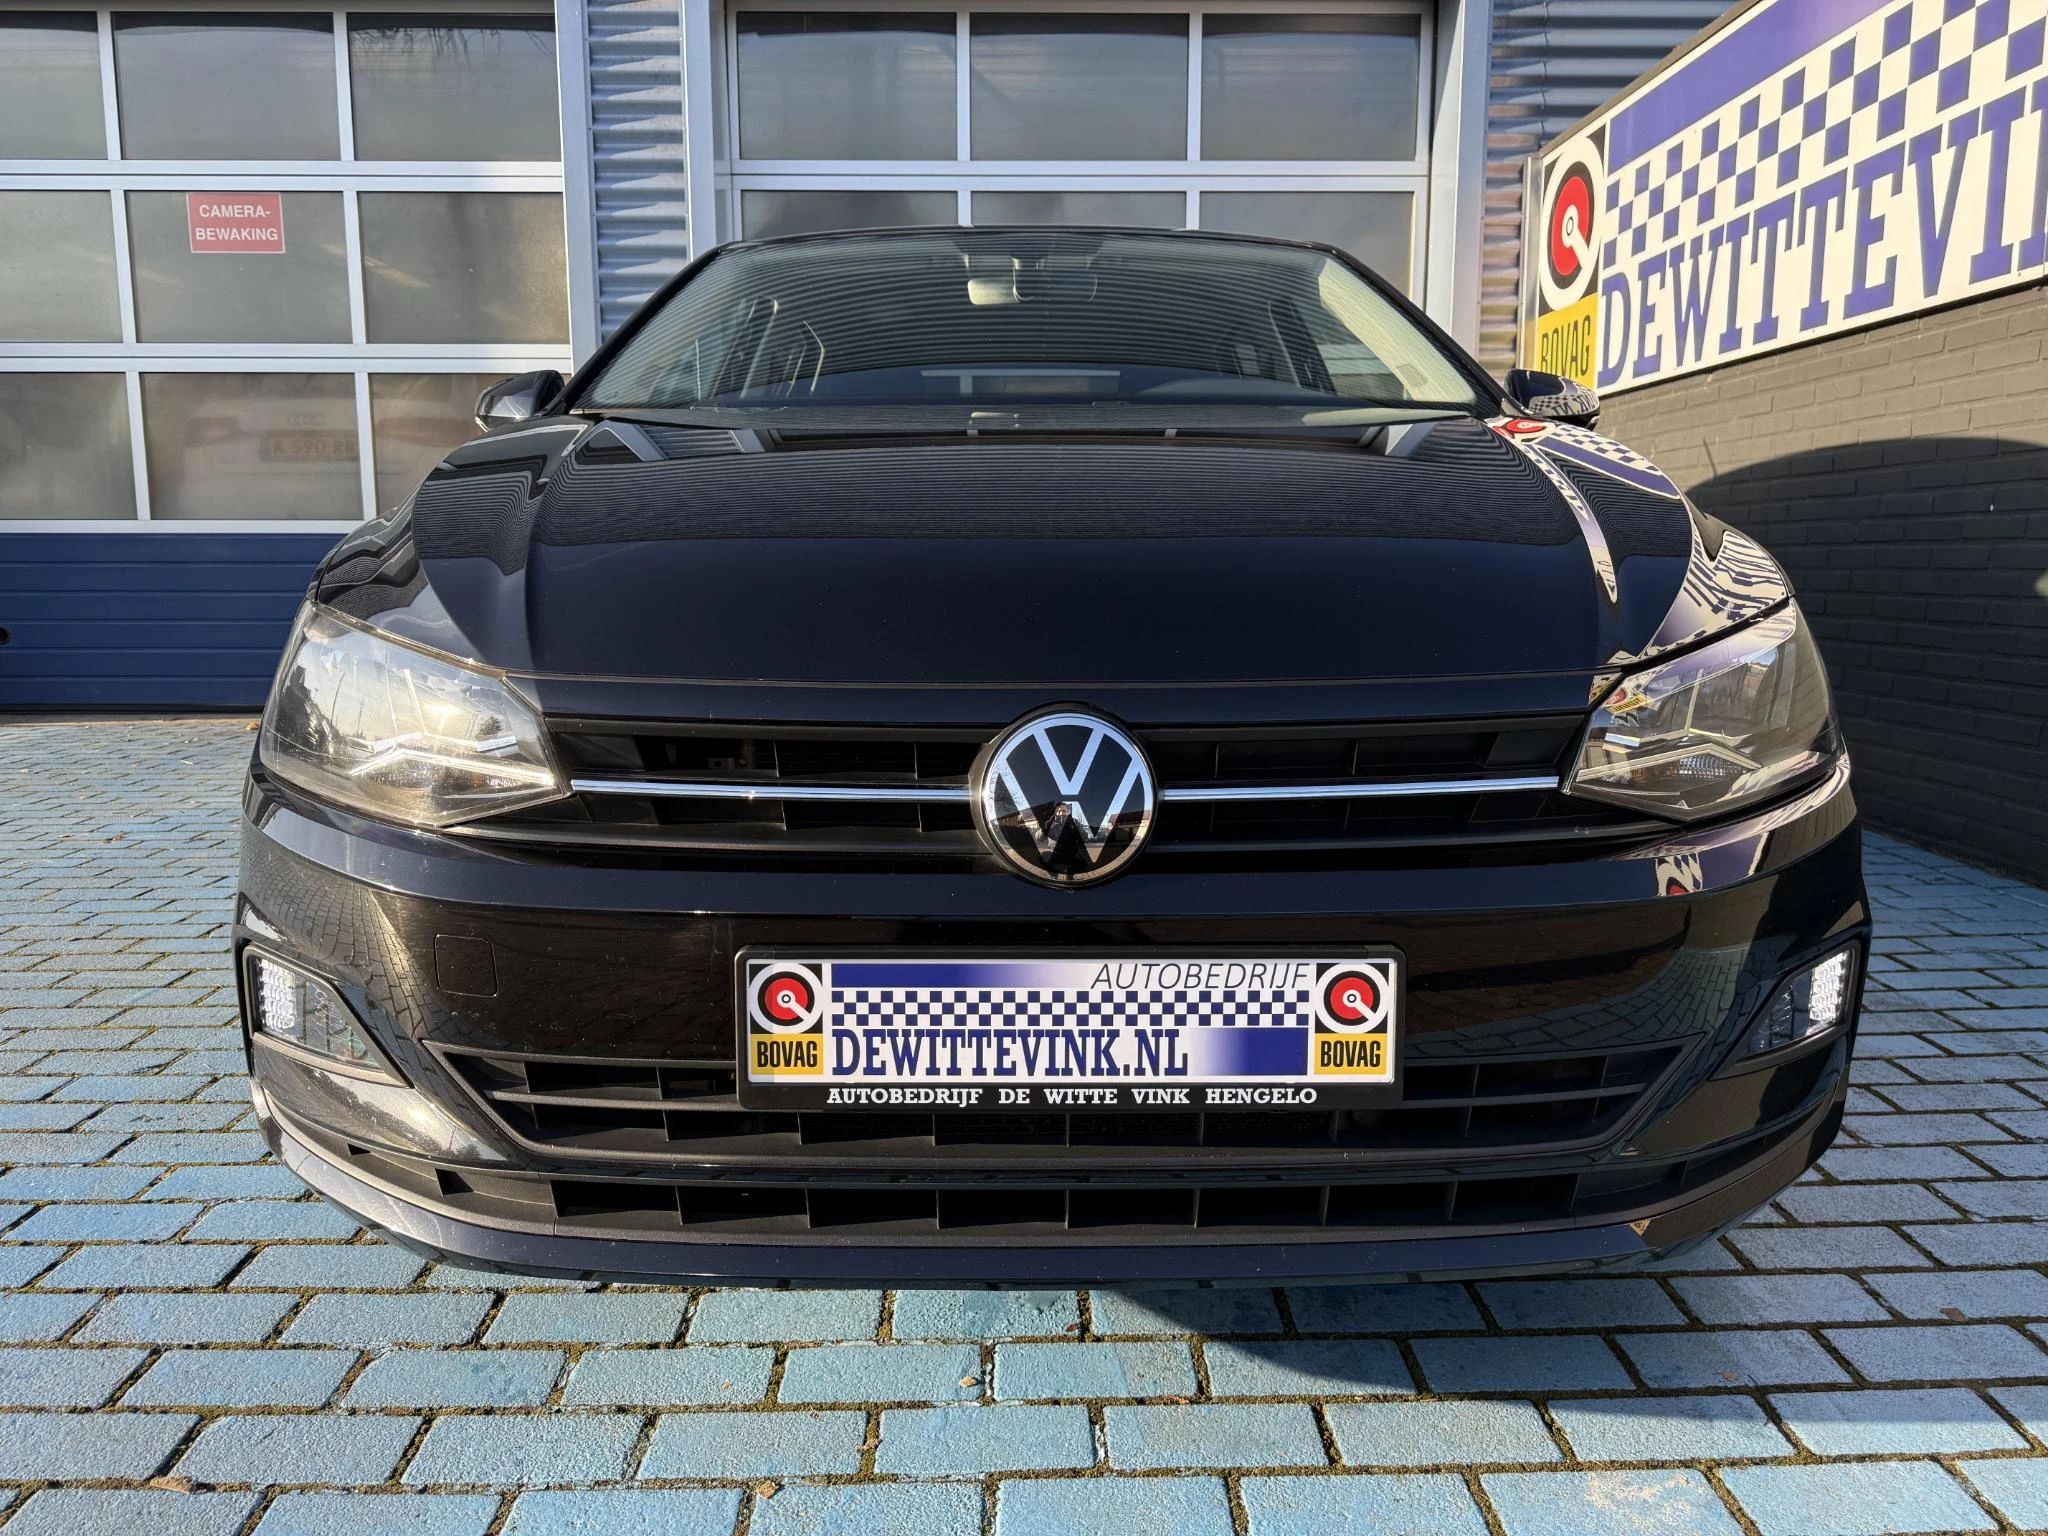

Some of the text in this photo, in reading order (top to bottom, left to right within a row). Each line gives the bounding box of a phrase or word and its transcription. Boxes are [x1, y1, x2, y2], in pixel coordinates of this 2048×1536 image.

[199, 204, 271, 218] CAMERA-
[195, 227, 279, 241] BEWAKING
[1540, 314, 1592, 379] BOVAG
[1090, 962, 1311, 990] AUTOBEDRIJF
[756, 1040, 819, 1069] BOVAG
[831, 1028, 1189, 1077] DEWITTEVINK.NL
[1320, 1040, 1382, 1069] BOVAG
[827, 1088, 1318, 1108] AUTOBEDRIJF DE WITTE VINK HENGELO
